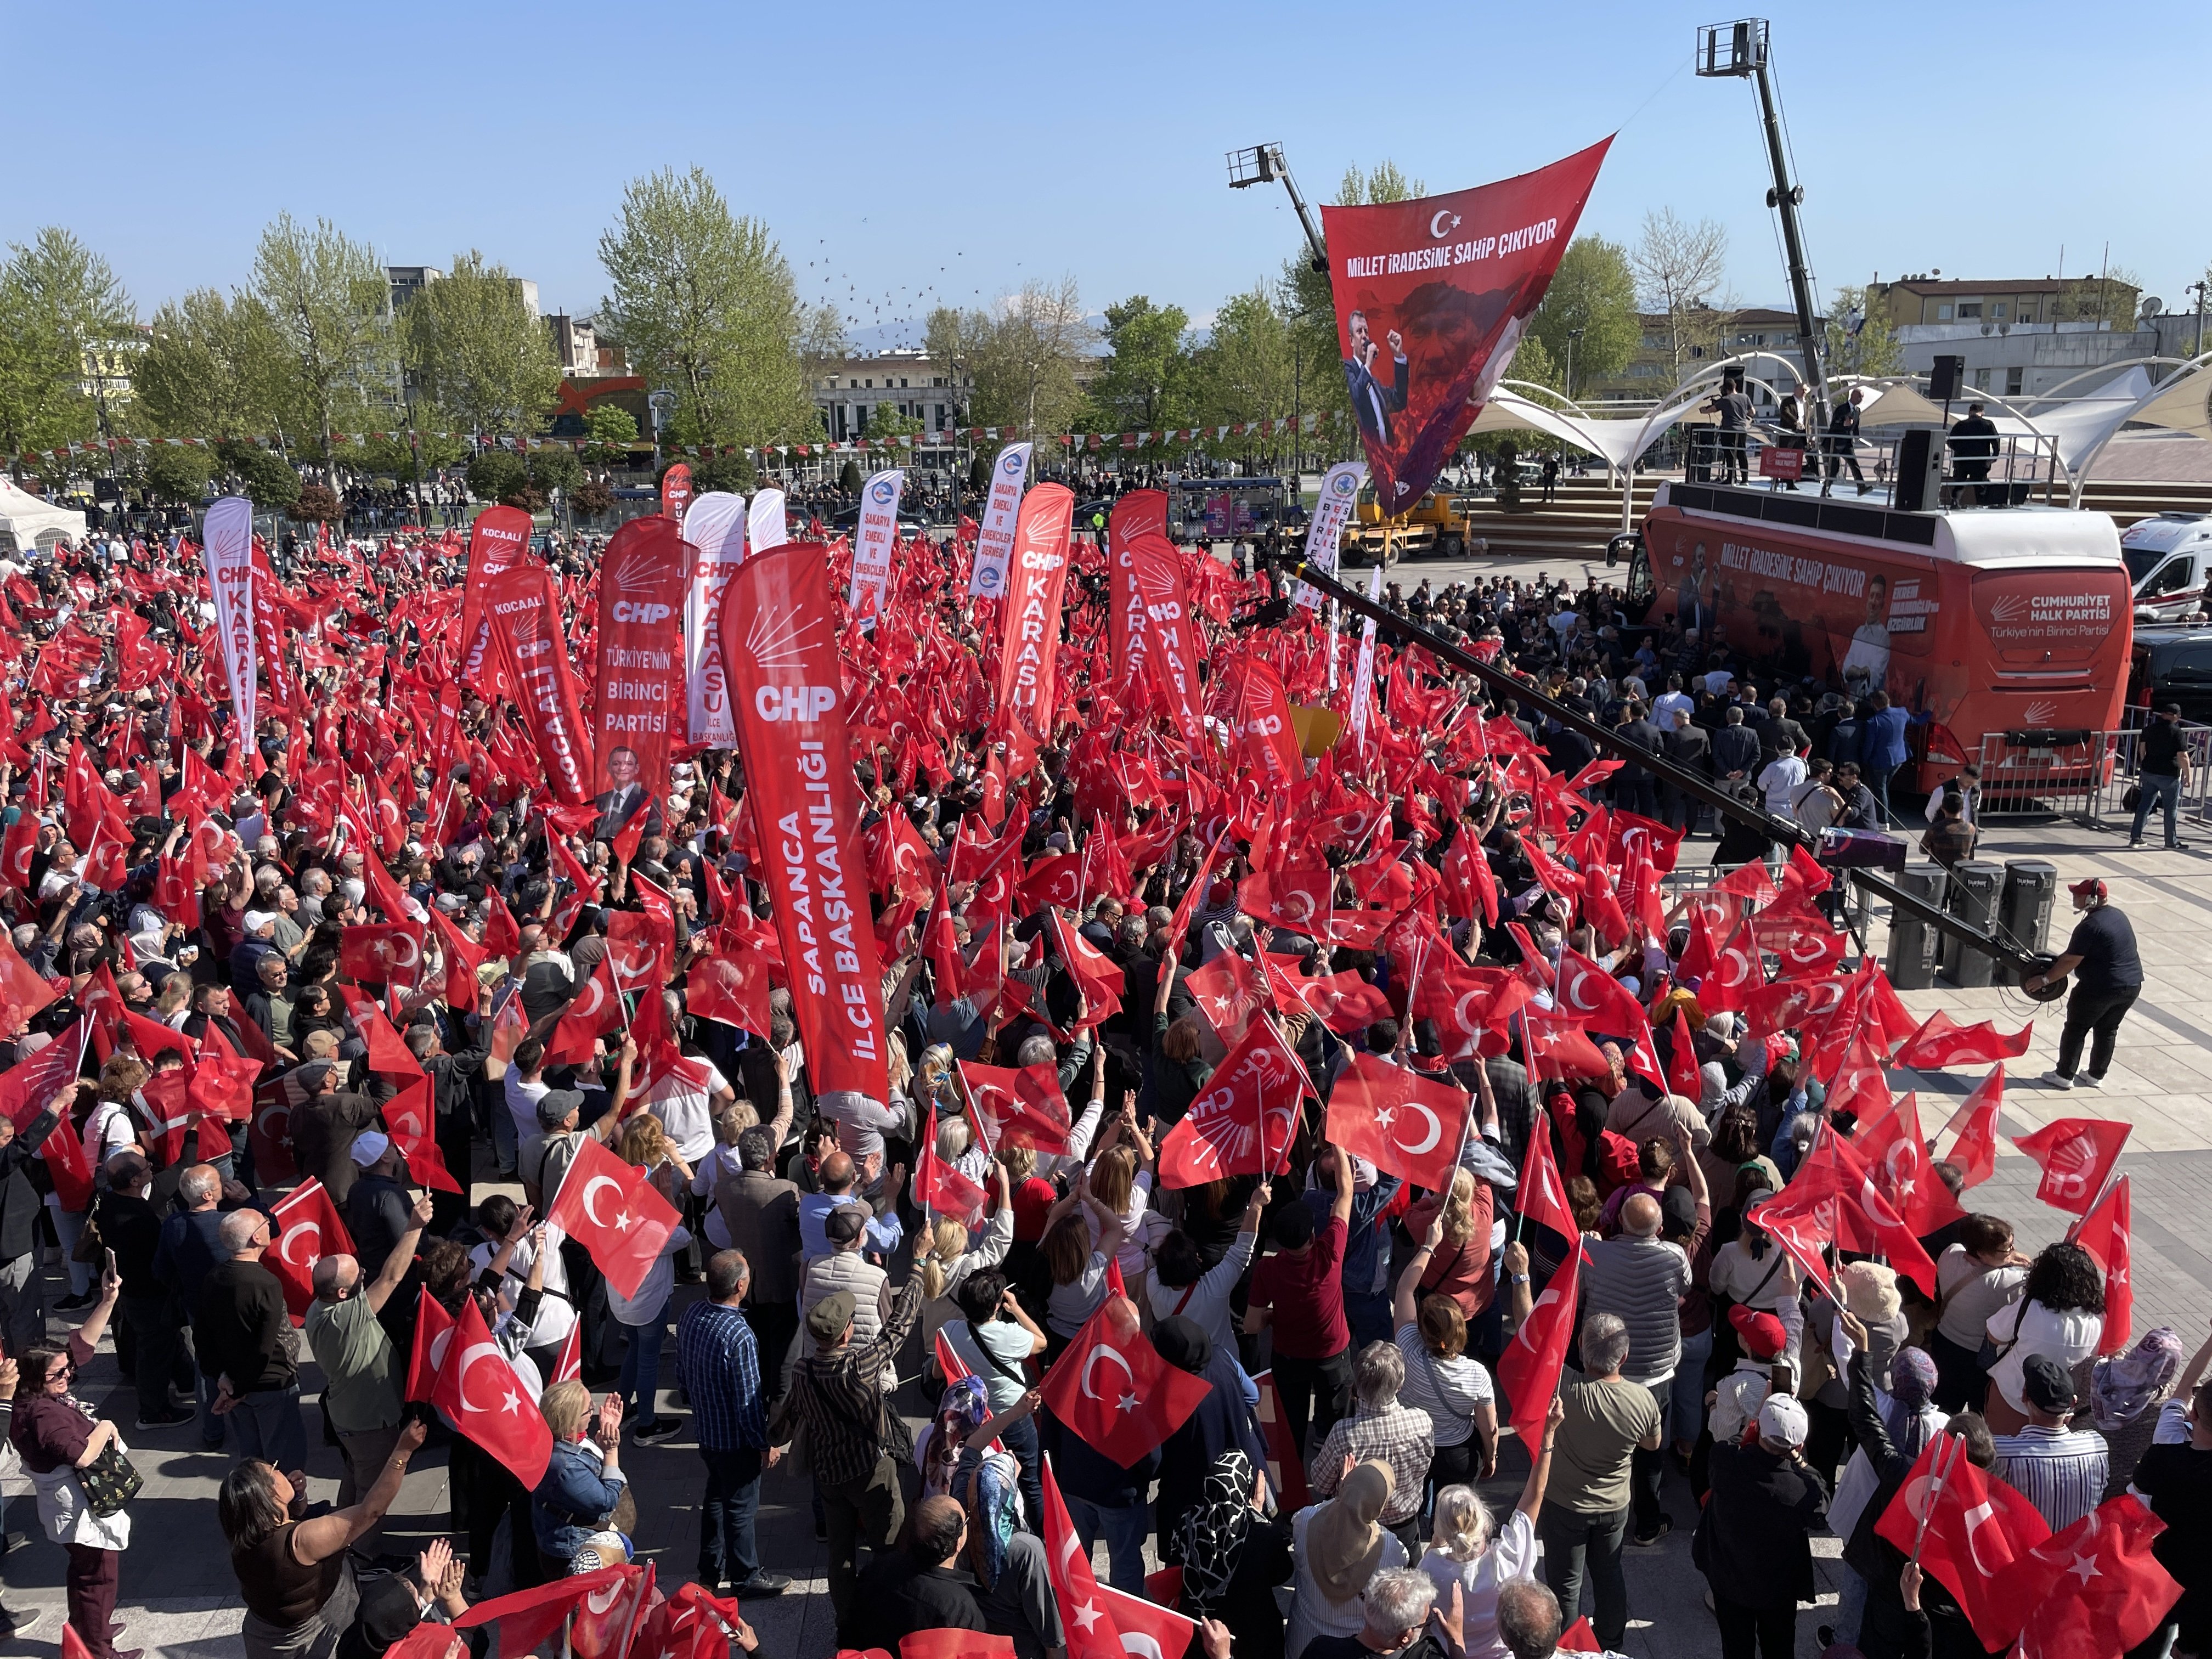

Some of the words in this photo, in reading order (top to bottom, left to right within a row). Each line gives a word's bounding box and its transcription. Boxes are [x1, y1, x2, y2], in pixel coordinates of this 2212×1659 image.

[1347, 255, 1386, 278] MİLLET
[1388, 245, 1452, 274] İRADESİNE
[1454, 236, 1496, 265] SAHİP
[1498, 217, 1558, 259] ÇIKIYOR
[669, 489, 688, 499] CHP
[995, 482, 1017, 497] SAKARYA
[993, 499, 1013, 512] EMEKLİ
[865, 512, 890, 528] SAKARYA
[996, 515, 1003, 526] VE
[482, 527, 522, 543] KOCAALİ
[865, 529, 887, 544] EMEKLİ
[869, 548, 877, 559] VE
[1022, 551, 1064, 572] CHP
[1673, 555, 1684, 567] CHP
[218, 566, 251, 583] CHP
[855, 561, 886, 579] EMEKÇİLER
[1720, 543, 1751, 571] MİLLET
[1749, 548, 1795, 582] İRADESİNE
[1793, 557, 1824, 588] SAHİP
[1822, 564, 1866, 598] ÇIKIYOR
[495, 592, 546, 615] KOCAALİ
[2031, 592, 2111, 608] CUMHURİYET
[612, 600, 670, 624] CHP
[2030, 610, 2063, 622] HALK
[2066, 606, 2110, 621] PARTİSİ
[1991, 625, 2045, 640] Türkiye'nin
[2046, 625, 2078, 637] Birinci
[2079, 624, 2109, 636] Partisi
[516, 639, 552, 659] CHP
[1012, 575, 1047, 708] KARASU
[606, 645, 671, 670] TÜRKİYE'NİN
[607, 678, 668, 702] BİRİNCİ
[755, 685, 837, 723] CHP
[522, 664, 583, 794] KOCAALİ
[606, 712, 668, 733] PARTİSİ
[707, 714, 720, 729] İLÇE
[693, 730, 736, 743] BAŞKANLIĞ
[797, 741, 861, 974] BAŞKANLIĞI
[778, 811, 826, 997] SAPANCA
[840, 983, 877, 1062] İLÇE
